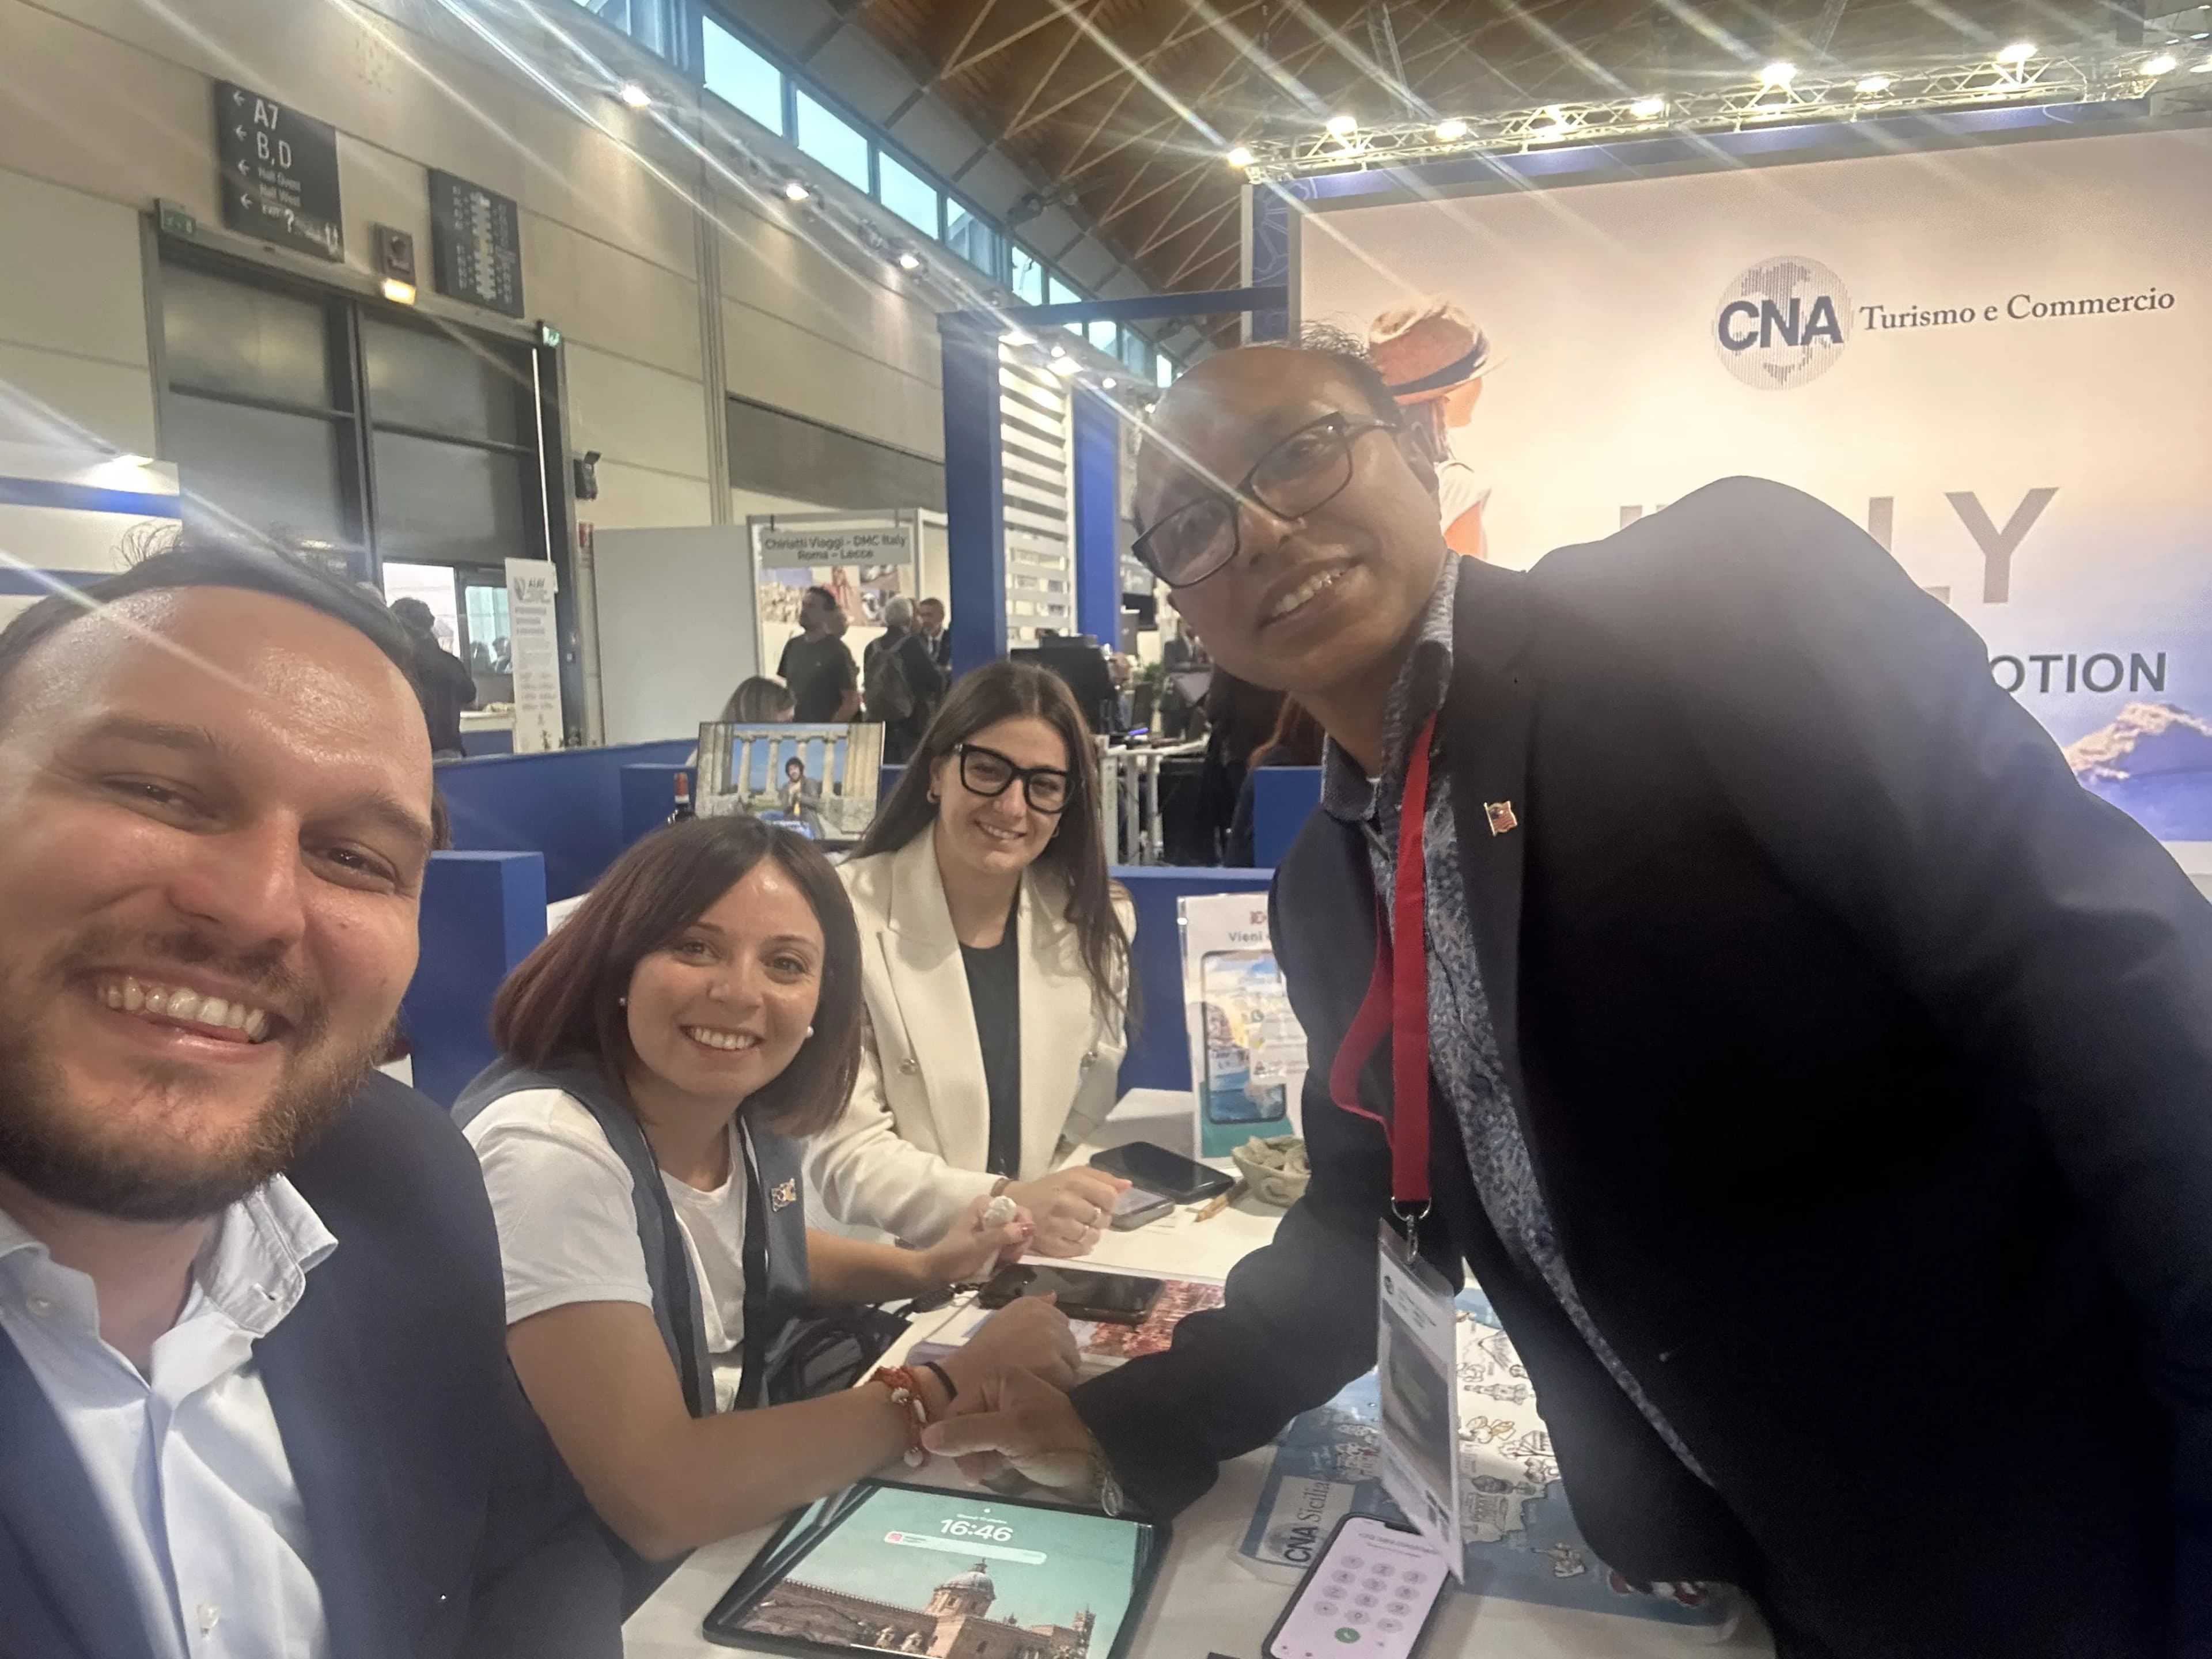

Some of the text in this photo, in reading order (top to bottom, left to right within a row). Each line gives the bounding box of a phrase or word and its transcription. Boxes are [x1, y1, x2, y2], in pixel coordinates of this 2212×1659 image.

[254, 99, 278, 130] A7
[279, 140, 291, 169] D
[1718, 296, 1844, 351] CNA
[1860, 287, 2175, 331] Turismo e Commercio
[853, 535, 881, 546] DMC
[881, 534, 906, 547] Italy
[1990, 652, 2166, 693] OTION
[941, 1519, 1013, 1541] 16:46
[1284, 1482, 1330, 1562] CNA Sicilia
